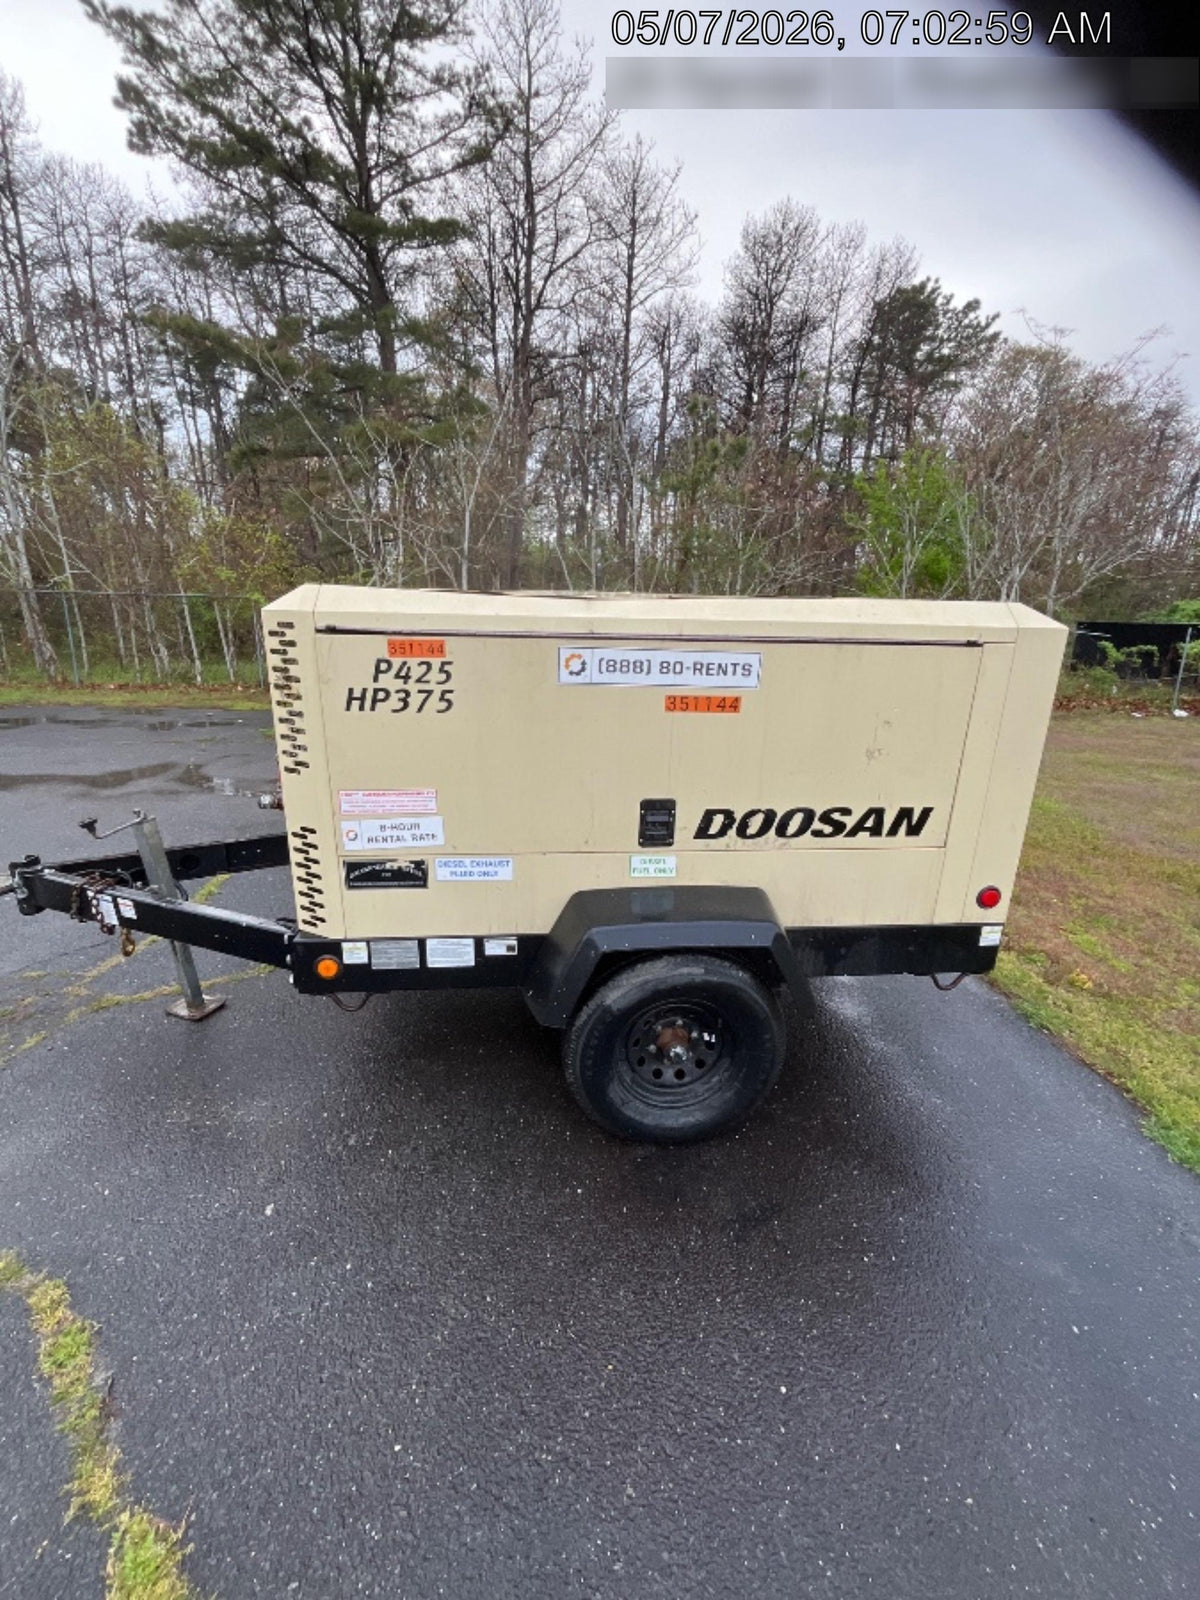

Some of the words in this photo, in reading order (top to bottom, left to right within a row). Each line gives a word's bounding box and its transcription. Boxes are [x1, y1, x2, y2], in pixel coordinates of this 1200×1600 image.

[389, 642, 444, 656] 351144
[373, 658, 454, 685] P425
[598, 657, 652, 676] (888)
[659, 660, 753, 677] 80-RENTS
[345, 687, 454, 714] HP375
[667, 695, 740, 713] 351144
[693, 807, 935, 840] DOOSAN
[367, 834, 407, 844] RENTAL
[411, 832, 438, 842] RATE
[438, 859, 468, 868] DIESEL
[470, 859, 511, 868] EXHAUST
